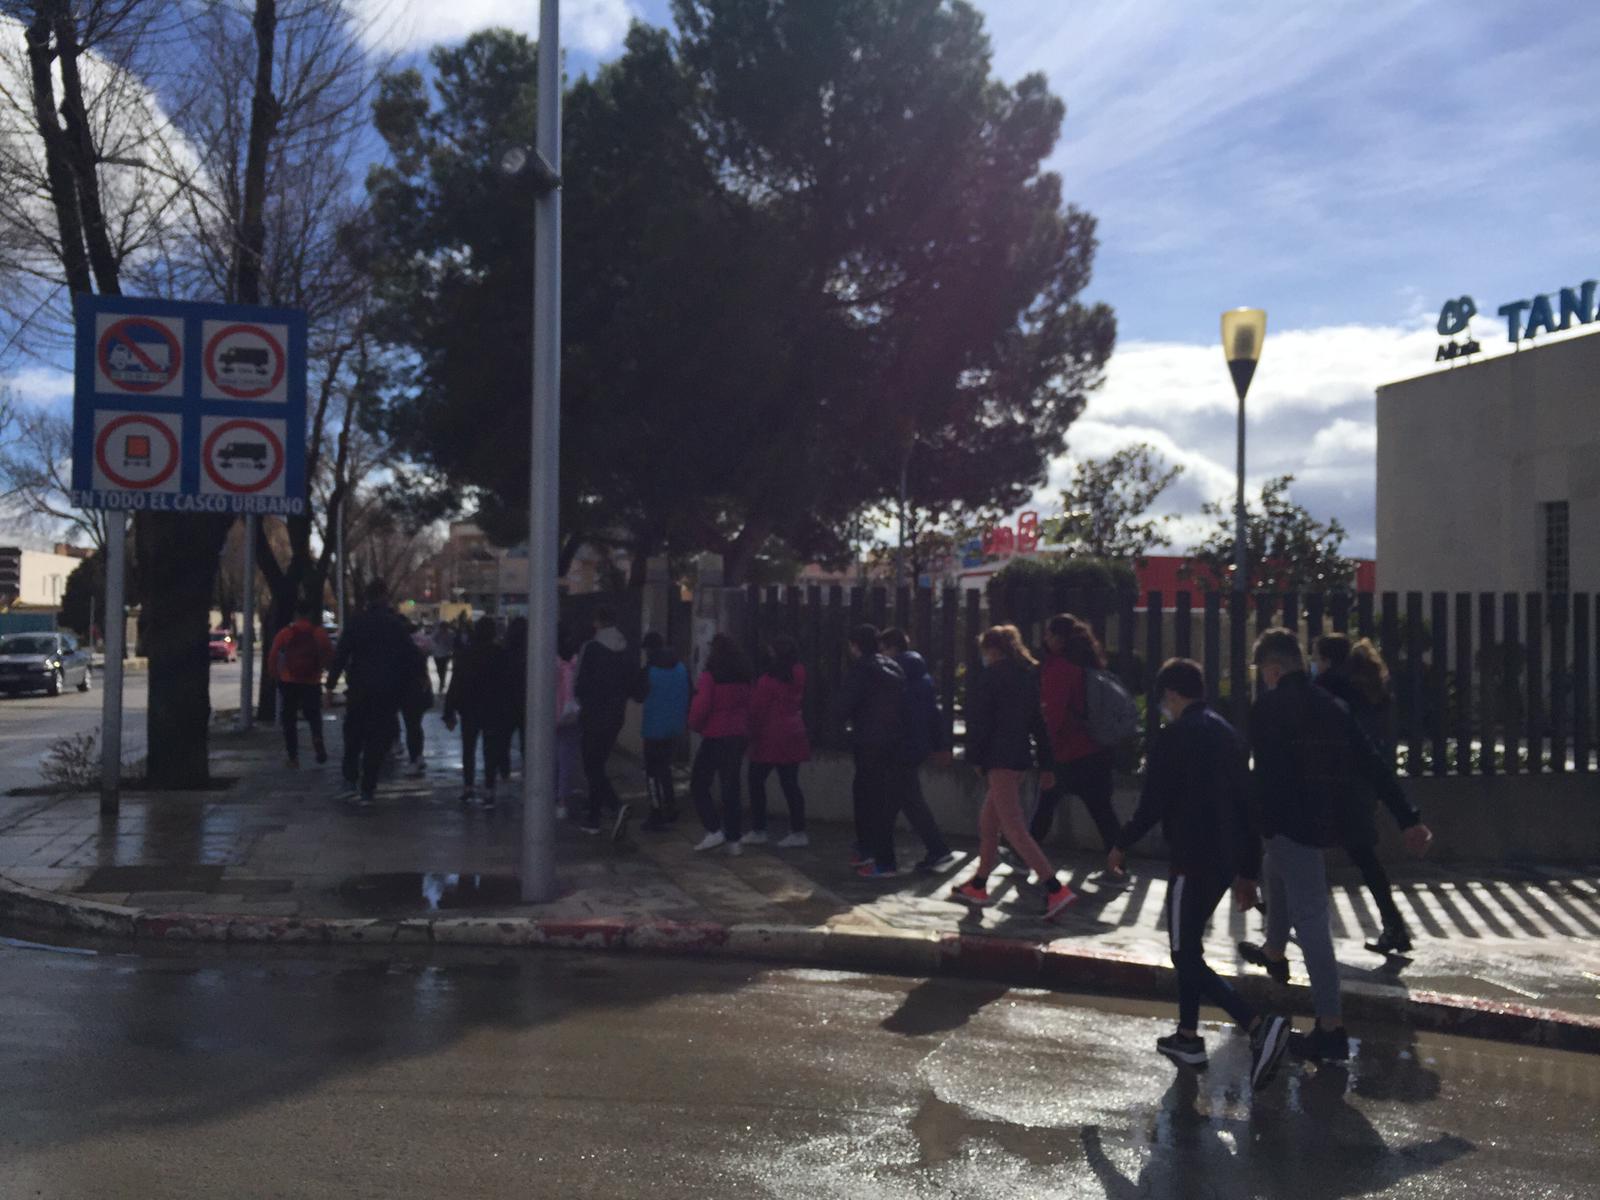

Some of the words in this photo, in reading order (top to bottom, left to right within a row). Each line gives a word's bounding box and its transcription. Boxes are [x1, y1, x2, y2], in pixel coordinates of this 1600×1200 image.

[1498, 279, 1600, 342] TAN
[71, 490, 94, 507] EN
[100, 491, 145, 509] TODO
[152, 493, 169, 510] EL
[174, 494, 230, 512] CASCO
[232, 495, 302, 513] URBANO
